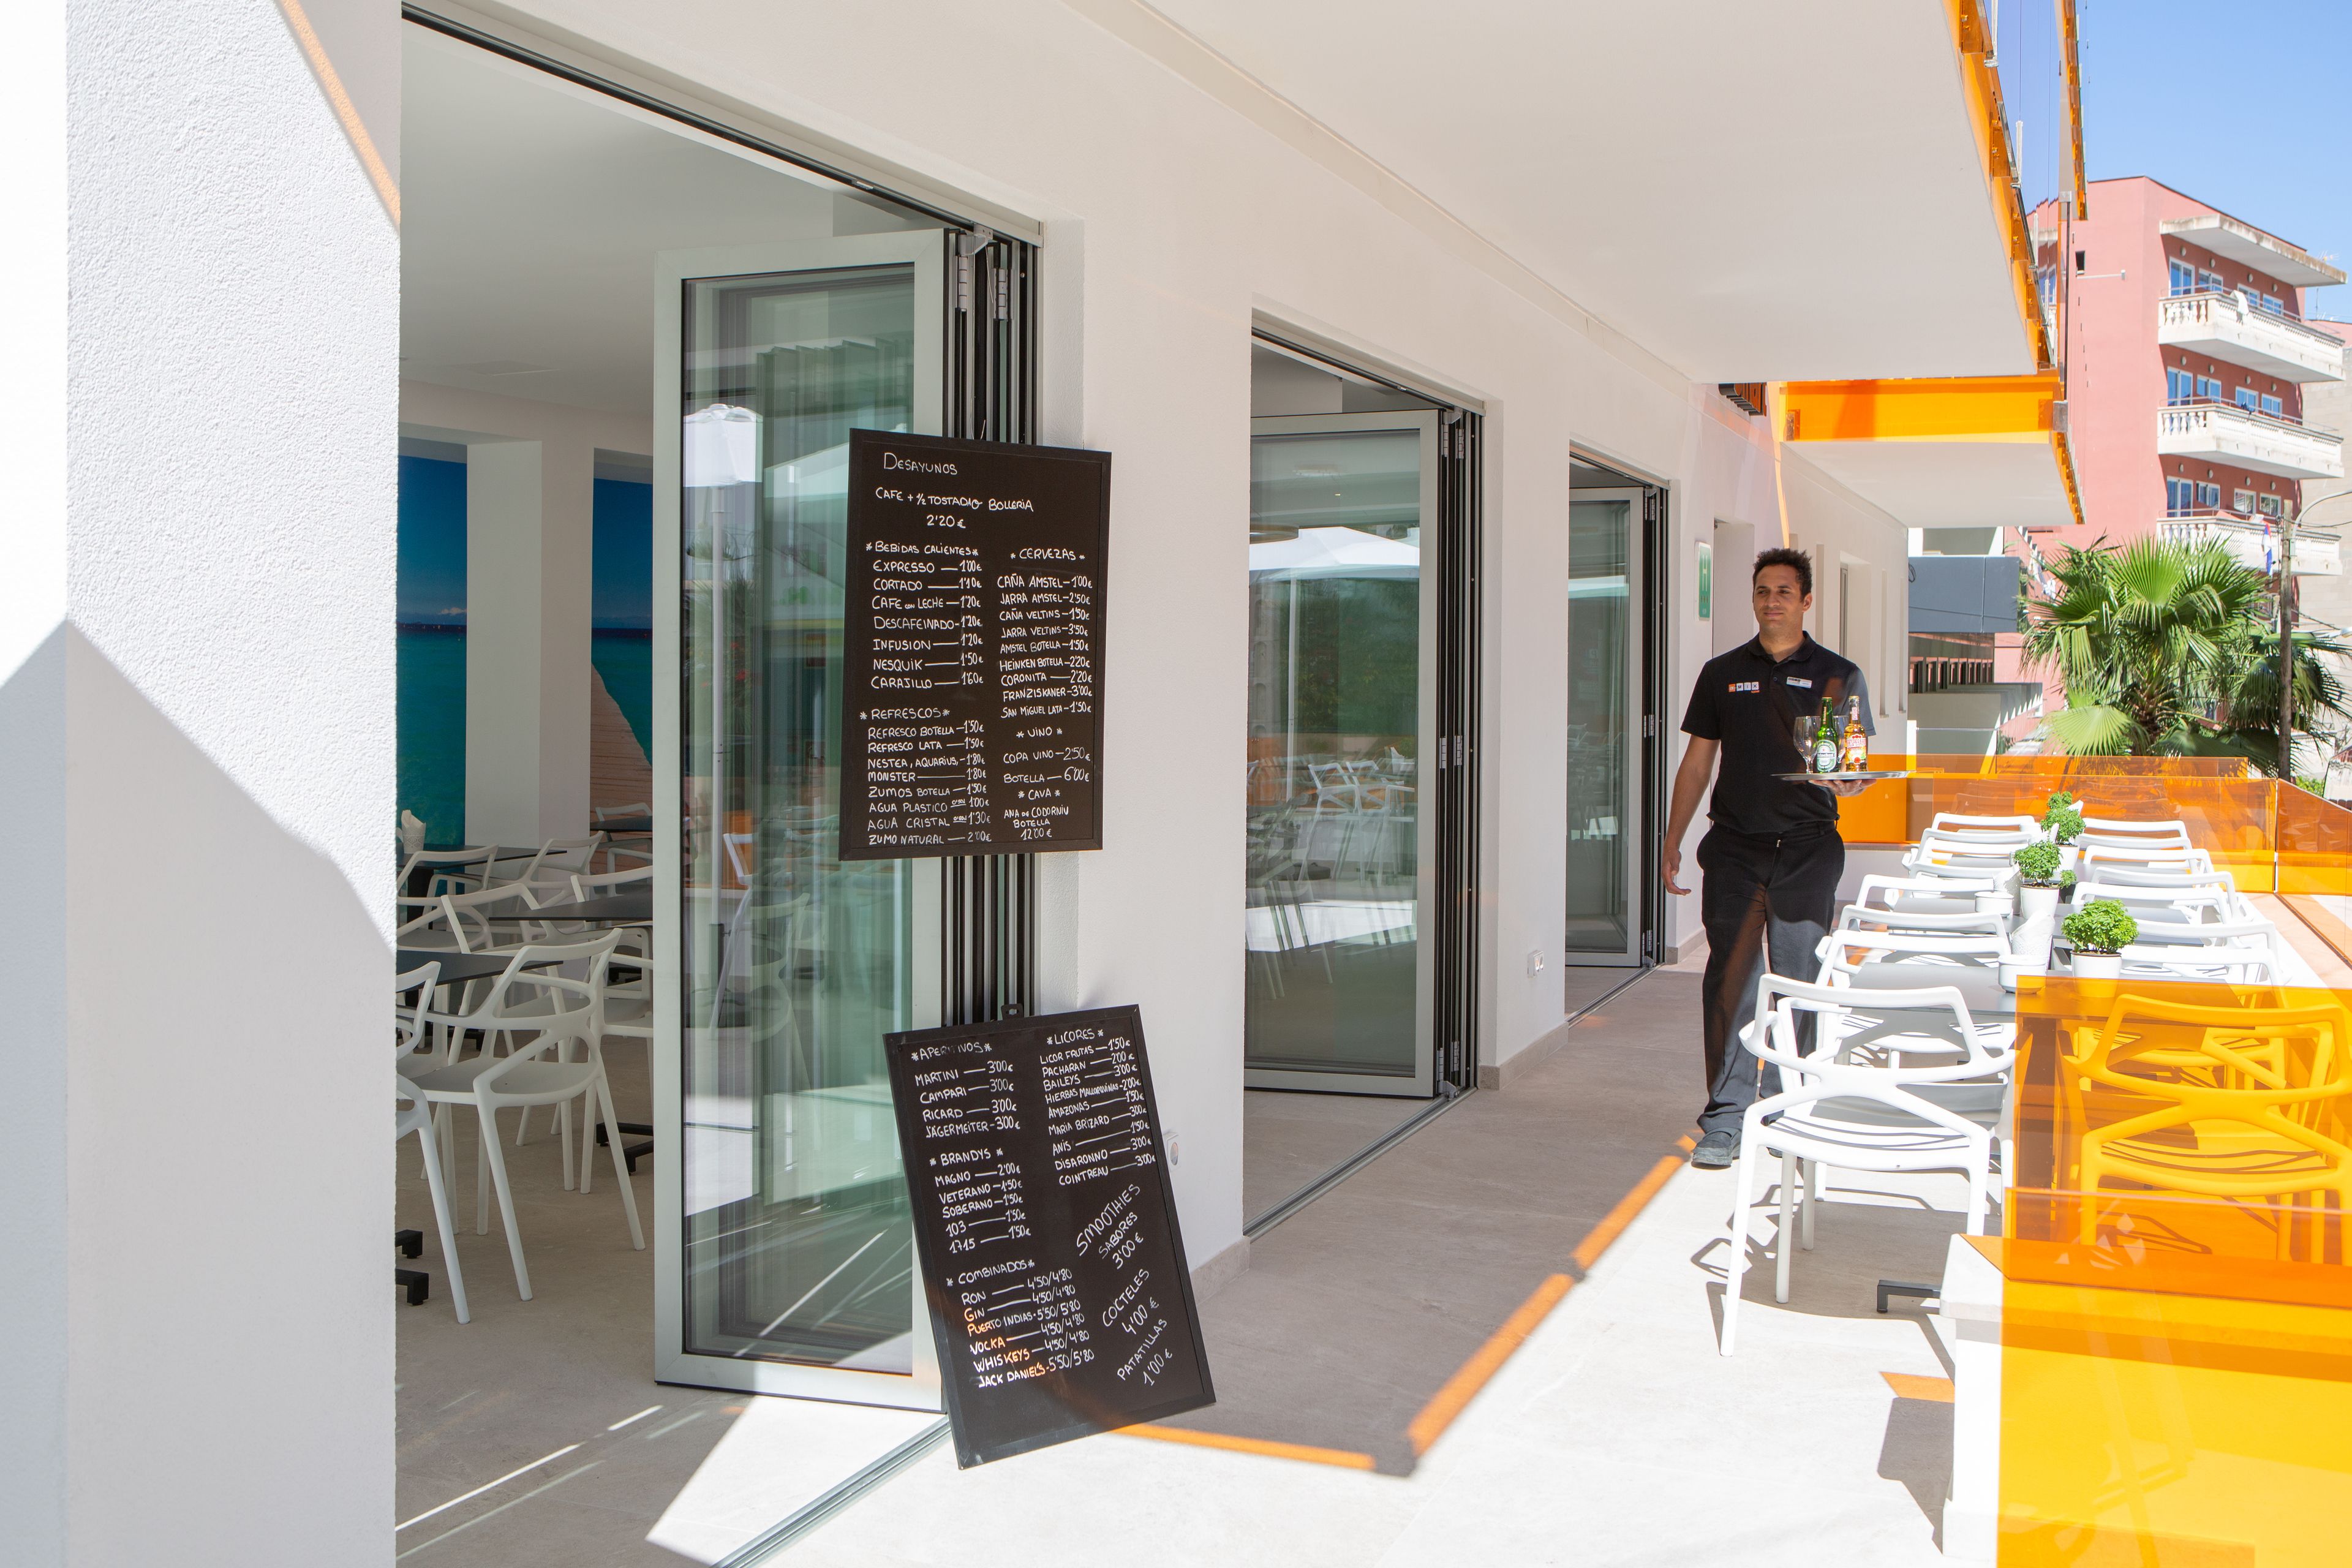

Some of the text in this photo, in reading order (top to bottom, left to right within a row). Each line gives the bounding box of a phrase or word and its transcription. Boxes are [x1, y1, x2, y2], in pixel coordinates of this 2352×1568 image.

[883, 451, 958, 475] DESAYUNOS
[875, 486, 904, 502] CAFE
[875, 540, 971, 556] BEBIDAS CALIENTES
[1019, 547, 1076, 561] CERVEZAS
[873, 559, 935, 574] EXPRESSO
[873, 578, 923, 592] CORTADO
[997, 572, 1025, 589] CAÑA
[1028, 575, 1063, 589] AMSTEL
[872, 595, 903, 610] CAFE
[917, 596, 944, 609] LECHE
[1000, 592, 1028, 605] JARRA
[1031, 593, 1063, 604] AMSTEL
[999, 607, 1023, 621] CAÑA
[1025, 609, 1061, 620] VELTINS
[873, 616, 955, 630] DESCAFEINADO
[1001, 627, 1028, 639] JARRA
[1030, 625, 1061, 636] VELTINS
[872, 638, 931, 652] INFUSION
[1000, 643, 1028, 654] AMSTEL
[1030, 640, 1061, 652] BOTELLA
[873, 658, 923, 672] NESQUIK
[999, 658, 1036, 672] HEINKEN
[1036, 657, 1064, 668] BOTELLA
[870, 676, 932, 690] CARAJILLO
[1001, 671, 1047, 687] CORONITA
[1003, 688, 1066, 703] FRANZISKANER
[870, 707, 941, 720] REFRESCOS
[1000, 706, 1017, 718] SAN
[1019, 705, 1046, 717] MIGUEL
[1047, 704, 1063, 715] LATA
[867, 726, 917, 741] REFRESCO
[919, 725, 955, 737] BOTELLA
[1027, 726, 1053, 737] VINO
[867, 741, 914, 754] REFRESCO
[919, 741, 943, 750] LATA
[1003, 752, 1029, 764] COPA
[1033, 749, 1054, 760] VINO
[867, 771, 916, 783] MONSTER
[1003, 773, 1045, 783] BOTELLA
[868, 786, 913, 798] ZUMOS
[916, 788, 951, 797] BOTELLA
[1028, 788, 1052, 801] CAVA
[869, 802, 898, 813] AGUA
[902, 802, 948, 813] PLASTICO
[1003, 809, 1020, 819] ANA
[867, 816, 899, 832] AGUA
[906, 817, 951, 829] CRISTAL
[1012, 818, 1050, 829] BOTELLA
[869, 834, 897, 845] ZUMO
[900, 834, 944, 845] NATURAL
[1054, 1028, 1095, 1045] LICORES
[1039, 1051, 1064, 1065] LICOR
[1065, 1045, 1095, 1060] FRUTAS
[1042, 1060, 1086, 1077] PACHARAN
[914, 1068, 959, 1087] MARTINI
[1042, 1073, 1081, 1093] BAILEYS
[919, 1086, 967, 1104] CAMPARI
[1044, 1088, 1079, 1105] HIERBAS
[922, 1107, 963, 1123] RICARD
[1048, 1101, 1090, 1120] AMAZONAS
[1048, 1121, 1073, 1136] MARIA
[1074, 1115, 1110, 1131] BRIZARD
[1052, 1139, 1072, 1157] ANIS
[940, 1148, 992, 1167] BRANDYS
[1054, 1148, 1108, 1171] DISARONNO
[934, 1170, 971, 1188] MAGNO
[1058, 1165, 1109, 1186] COINTREAU
[938, 1183, 991, 1205] VETERANO
[942, 1198, 993, 1219] SOBERANO
[1076, 1183, 1140, 1257] SMOOTHIES
[945, 1220, 967, 1238] 103
[1098, 1212, 1139, 1260] SABORES
[958, 1259, 1028, 1285] COMBINADOS
[960, 1291, 987, 1306] RON
[1102, 1268, 1150, 1327] COCTELES
[963, 1307, 985, 1322] GIN
[967, 1318, 1002, 1338] PUERTO
[1003, 1311, 1033, 1327] INDIAS
[1117, 1316, 1168, 1381] PATATILLAS
[973, 1348, 1030, 1373] WHISKEYS
[976, 1373, 1004, 1389] JACK
